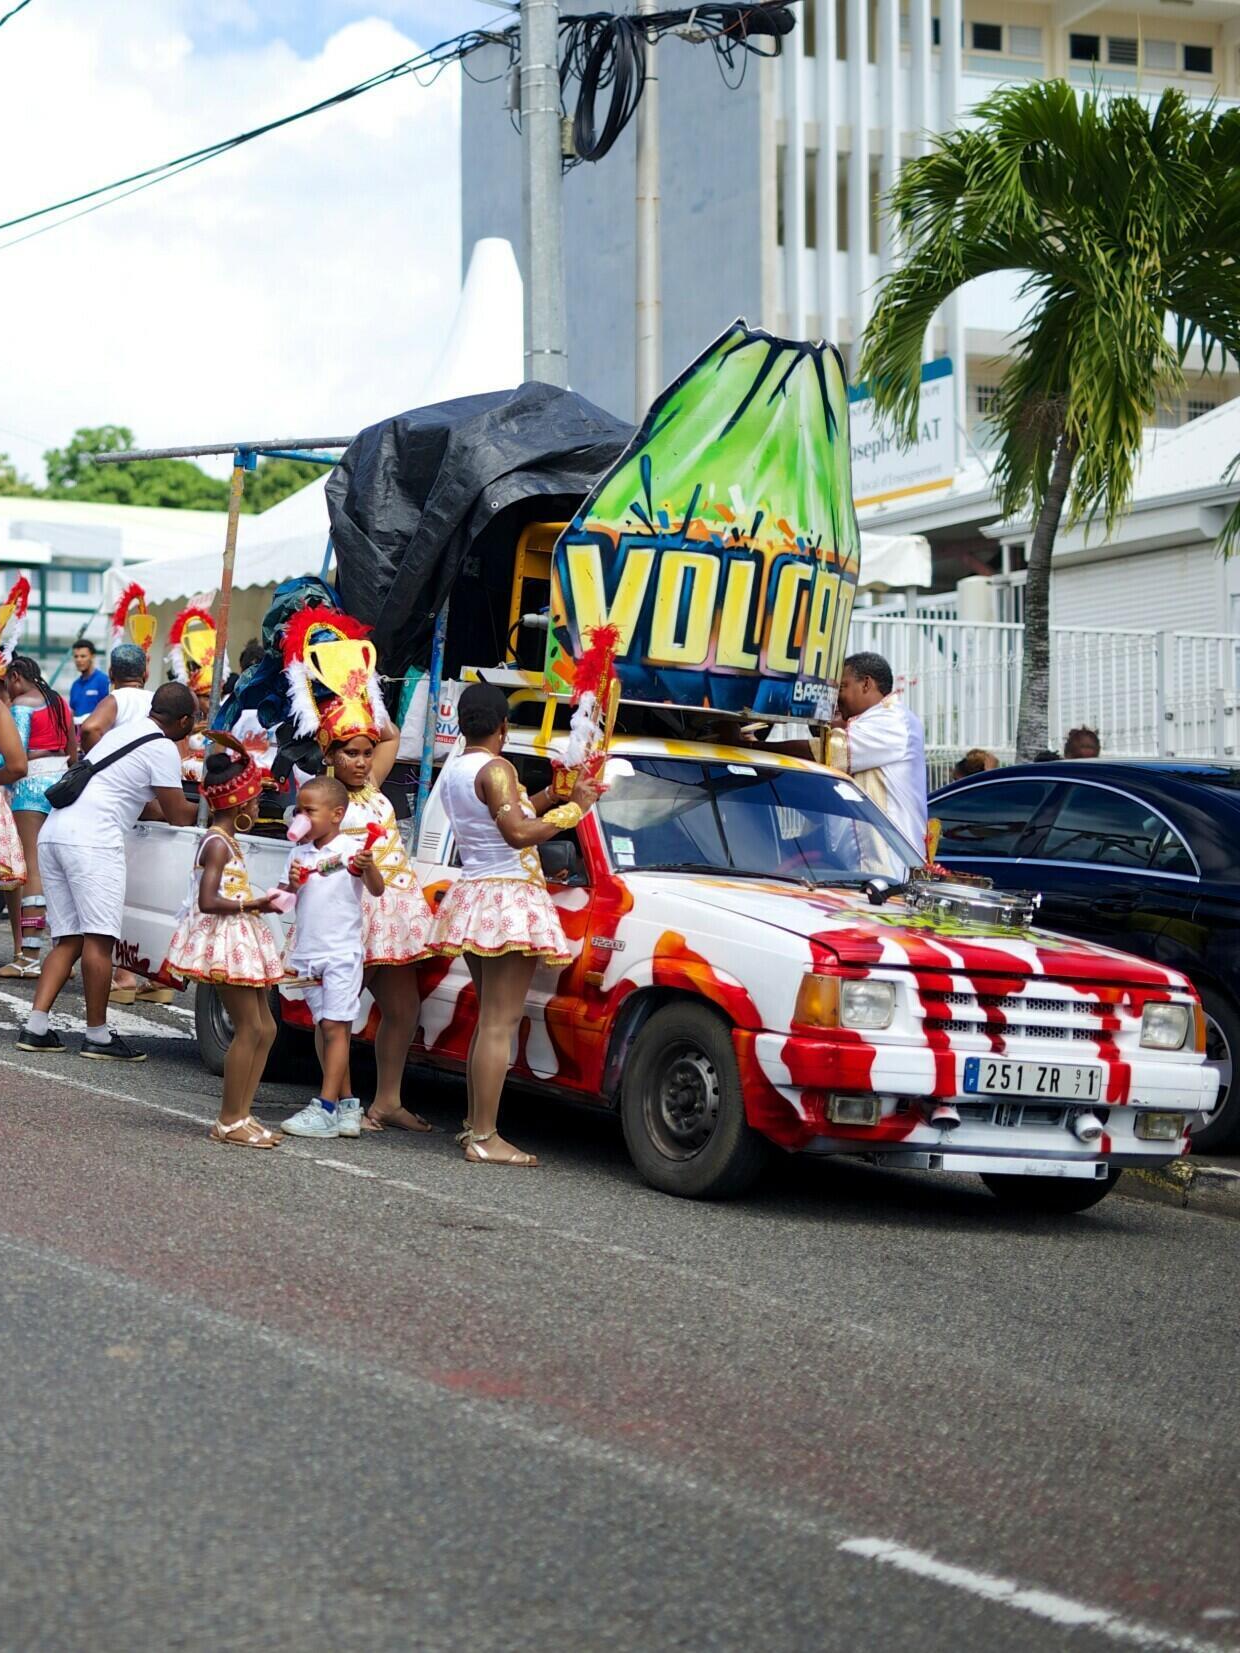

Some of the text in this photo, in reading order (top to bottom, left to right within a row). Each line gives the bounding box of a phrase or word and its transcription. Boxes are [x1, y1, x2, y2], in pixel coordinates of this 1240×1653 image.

[851, 431, 890, 464] oseph
[985, 1063, 1023, 1091] 251
[1036, 1066, 1061, 1093] ZR
